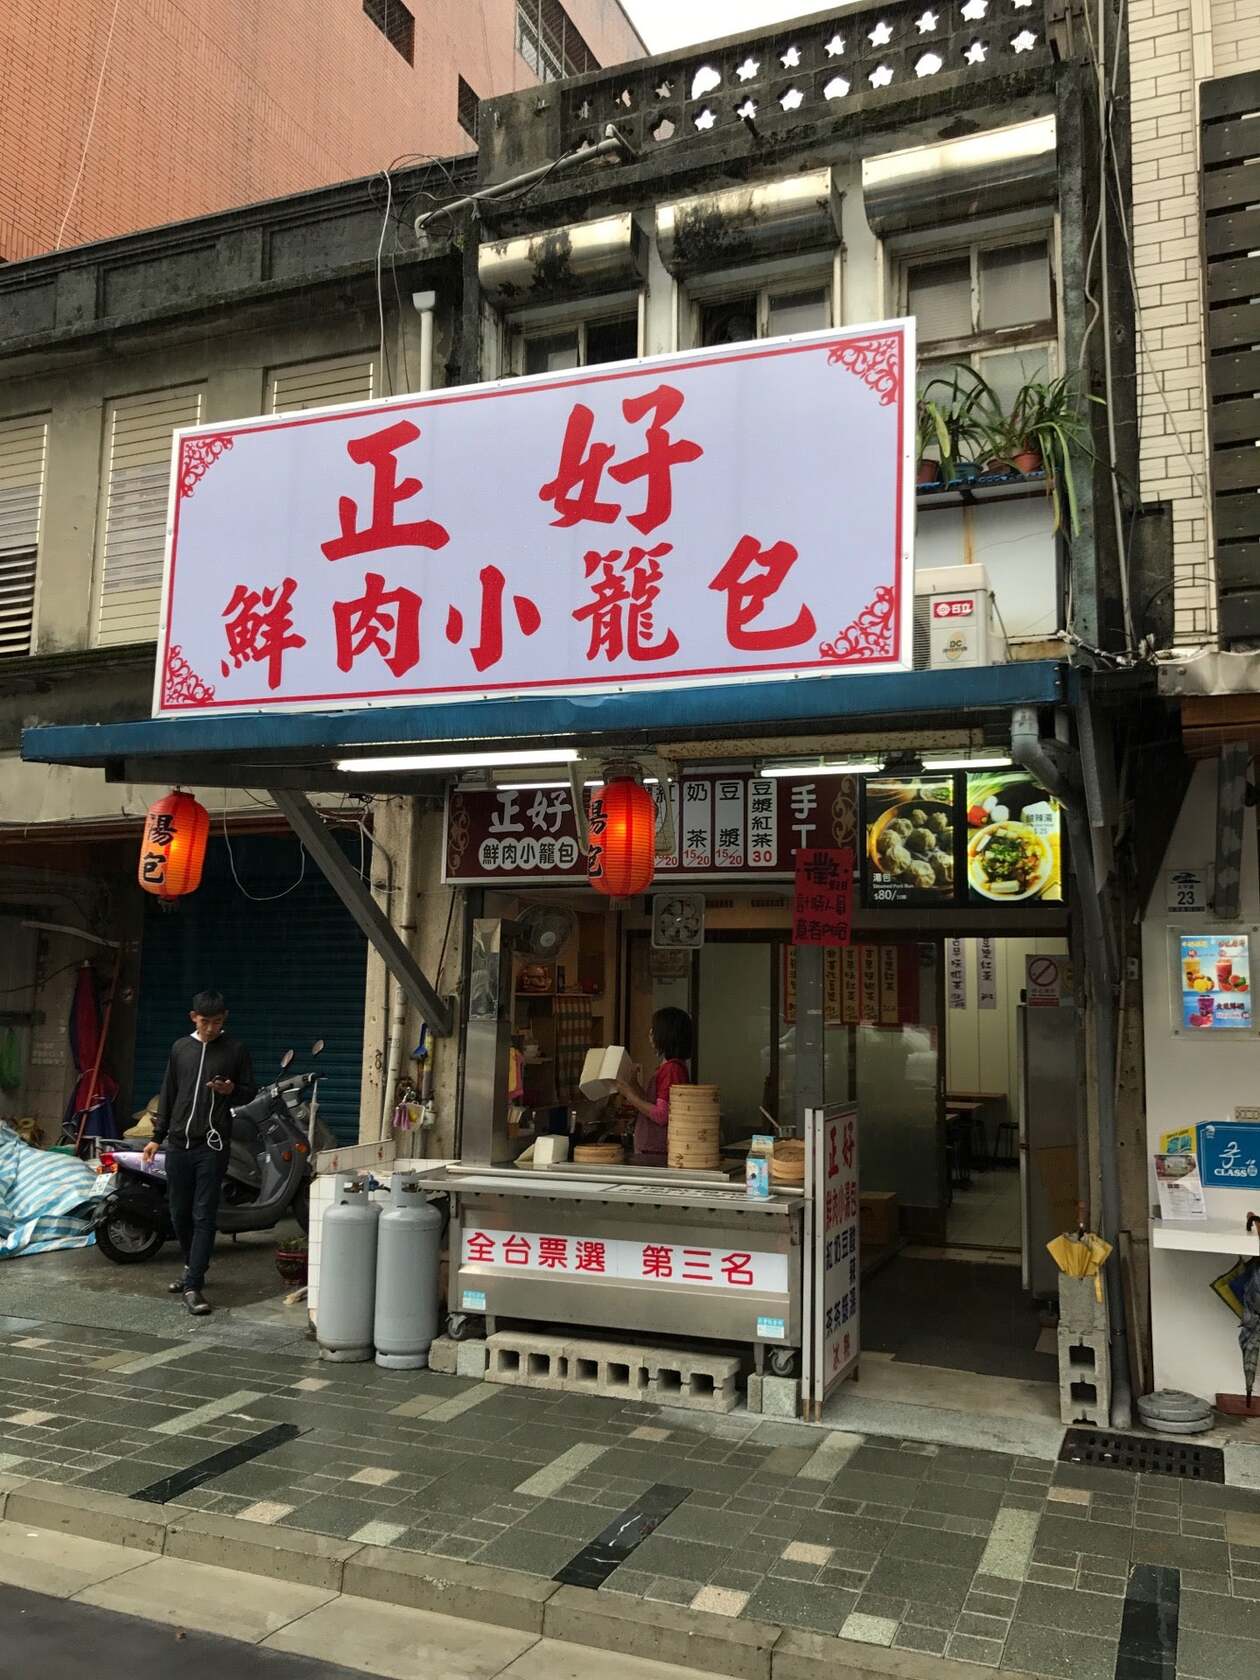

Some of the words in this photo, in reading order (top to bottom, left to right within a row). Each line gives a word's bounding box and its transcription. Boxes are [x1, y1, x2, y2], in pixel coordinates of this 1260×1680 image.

[321, 384, 703, 562] 正好
[221, 534, 817, 690] 鮮肉小籠包
[488, 790, 572, 834] 正好
[687, 783, 708, 848] 奶茶
[719, 782, 740, 848] 豆漿
[751, 781, 773, 848] 豆漿紅茶
[482, 841, 575, 866] 鮮肉小籠包
[683, 849, 710, 866] 15/20
[715, 848, 743, 865] 15/20
[752, 851, 773, 863] 30
[1177, 891, 1195, 905] 23
[828, 1121, 855, 1178] 正好
[1214, 1168, 1248, 1177] CLASS
[466, 1231, 606, 1273] 全台票選
[642, 1244, 754, 1286] 第三名
